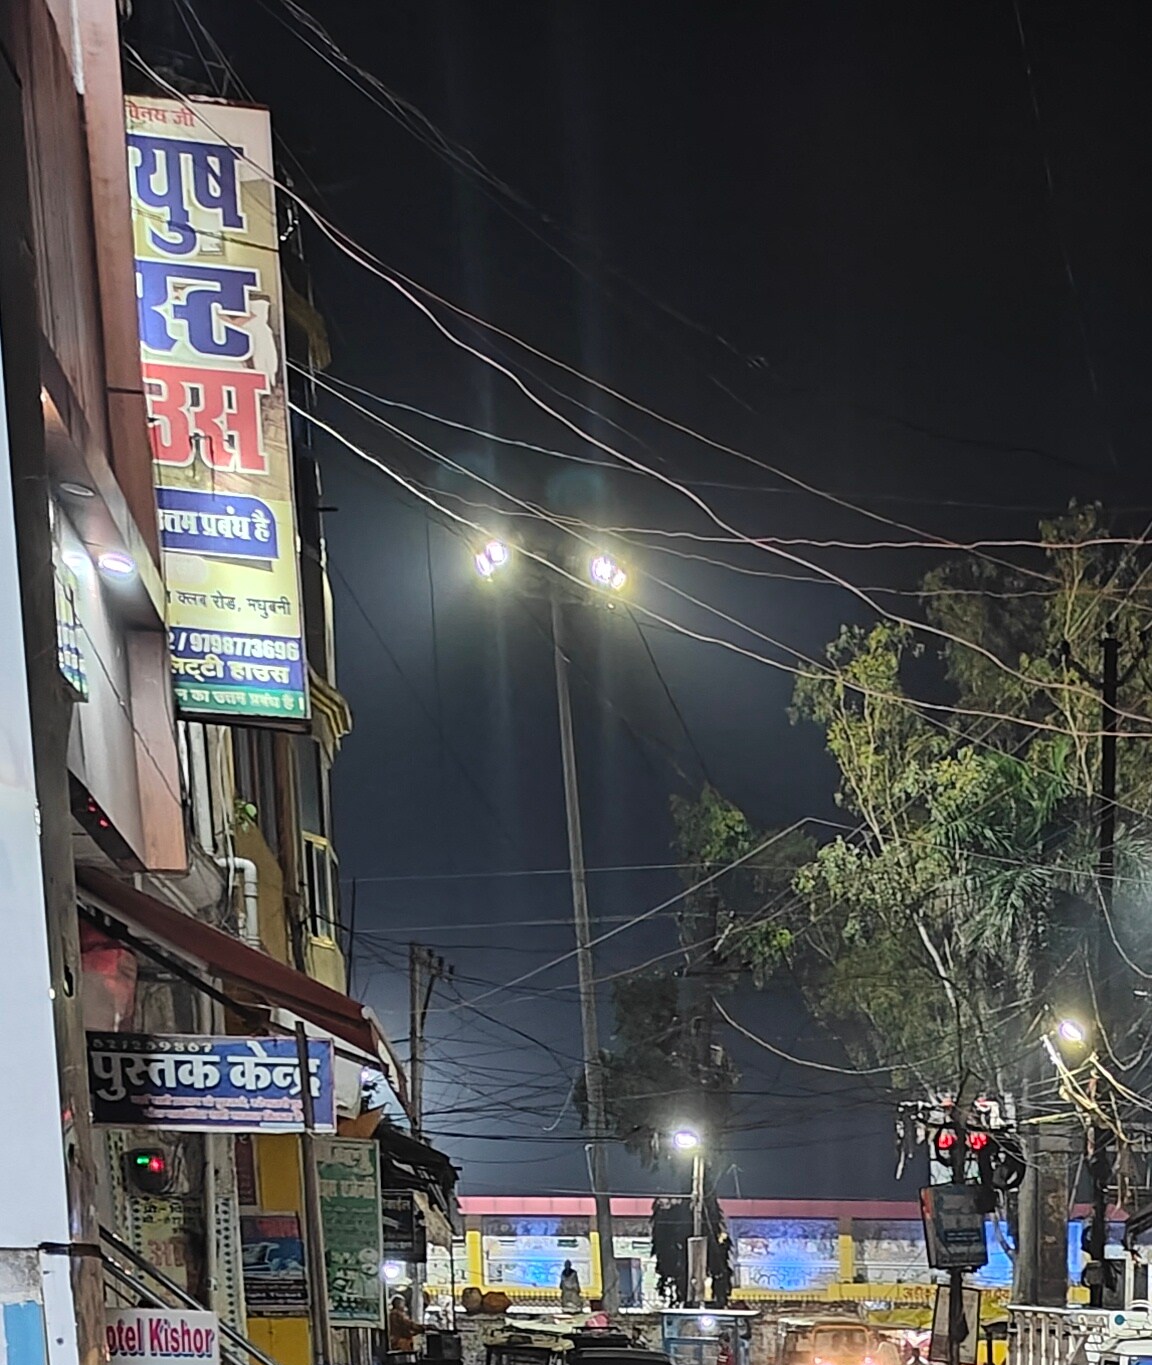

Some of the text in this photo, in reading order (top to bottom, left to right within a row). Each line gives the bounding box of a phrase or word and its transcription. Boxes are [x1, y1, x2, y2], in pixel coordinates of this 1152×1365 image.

[127, 133, 244, 255] युष
[91, 1051, 221, 1101] पुस्तक
[107, 1318, 214, 1352] otel Kishor
